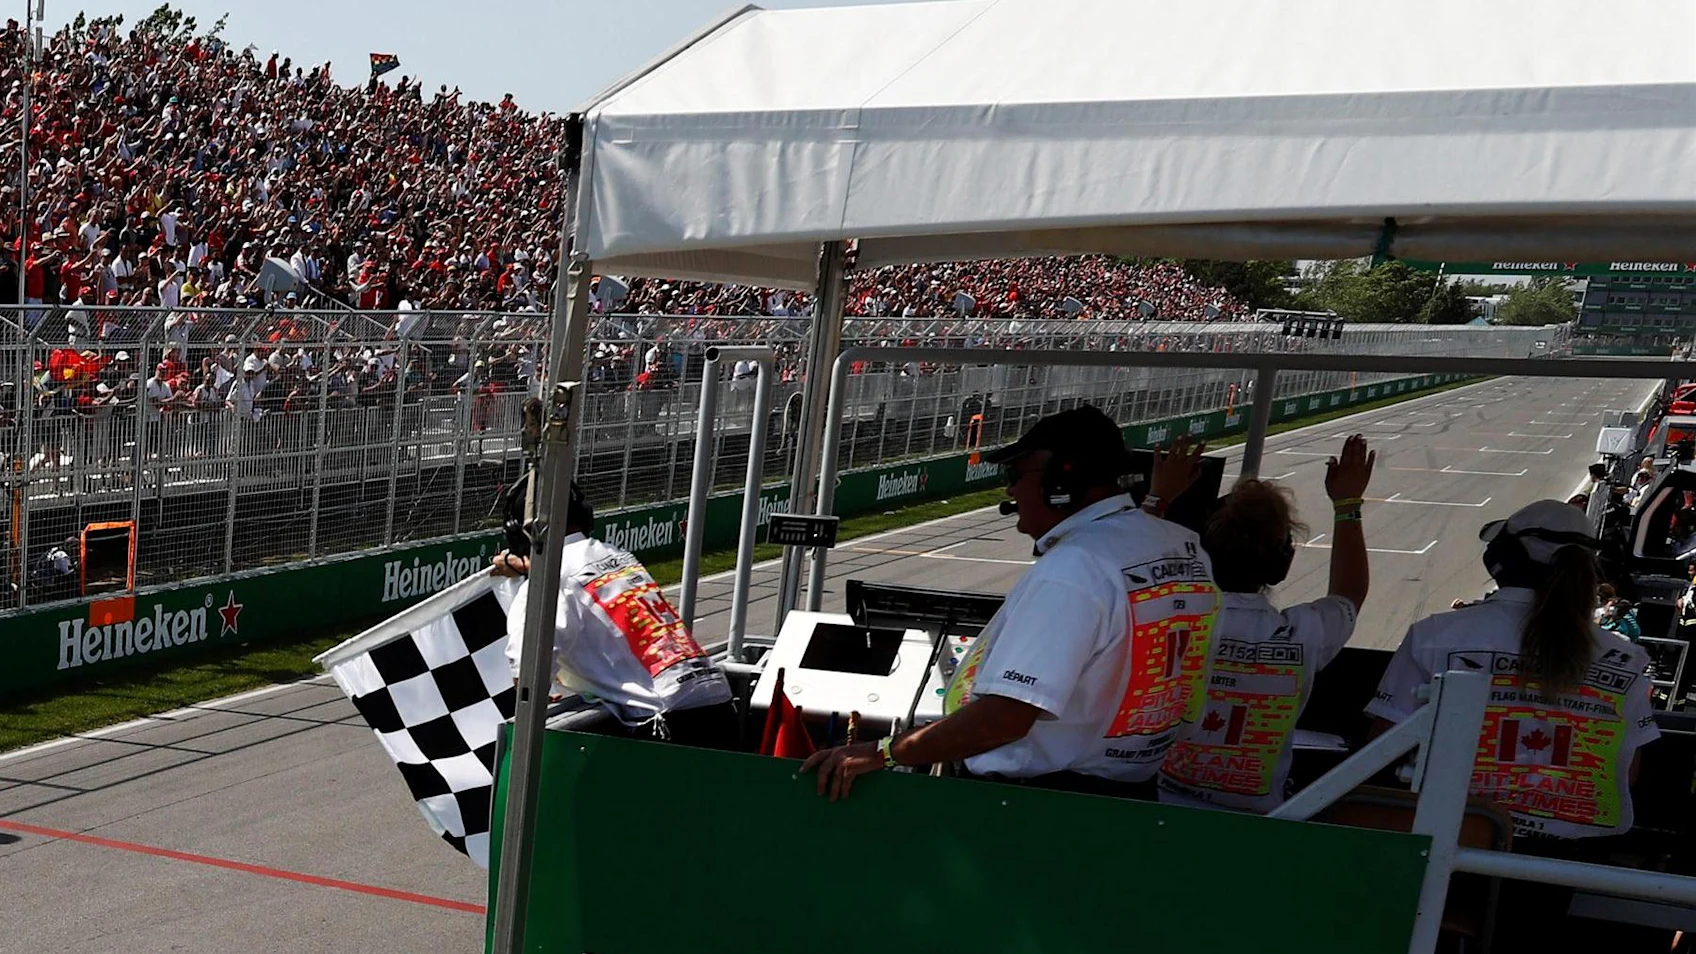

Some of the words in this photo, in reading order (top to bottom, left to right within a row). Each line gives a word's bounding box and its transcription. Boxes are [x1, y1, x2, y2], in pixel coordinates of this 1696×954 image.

[877, 470, 918, 500] Heineken
[757, 494, 791, 526] Heine
[605, 516, 673, 551] Heineken
[382, 548, 482, 602] Heineken
[1003, 669, 1037, 687] DÉPART
[1586, 668, 1631, 688] 2017
[1491, 691, 1516, 701] FLAG
[1520, 774, 1597, 799] LANE
